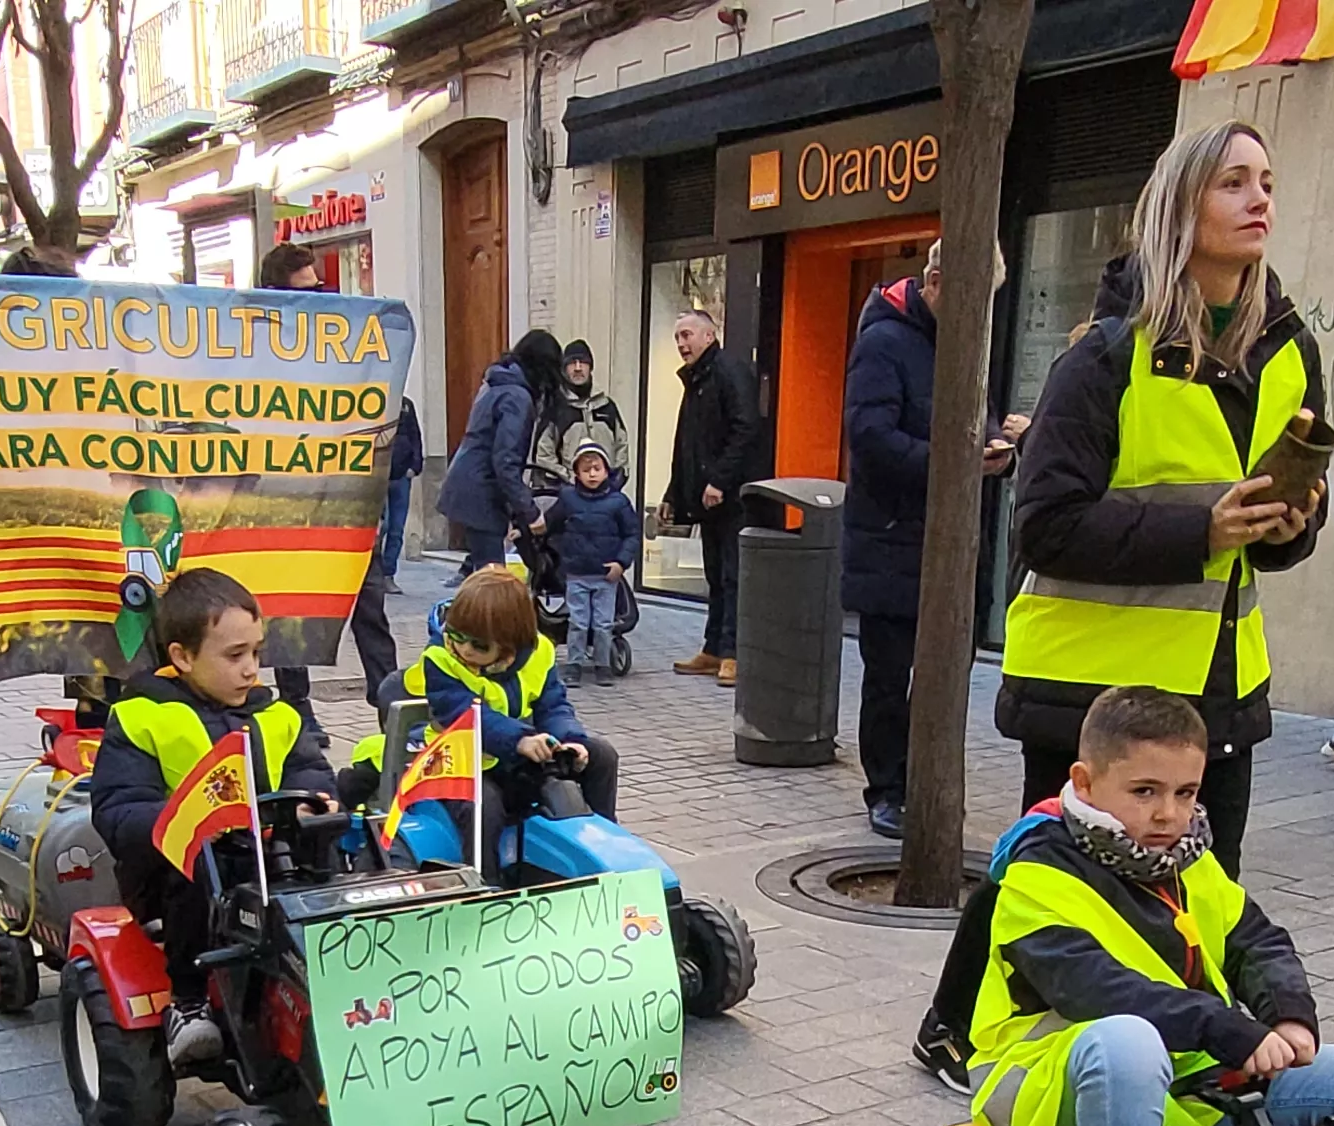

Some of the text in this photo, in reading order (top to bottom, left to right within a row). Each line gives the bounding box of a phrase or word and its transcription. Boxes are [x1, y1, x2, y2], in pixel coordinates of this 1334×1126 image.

[798, 134, 939, 202] Orange
[75, 369, 197, 419] FÁCIL
[205, 382, 387, 422] CUANDO
[81, 435, 177, 473] CON
[189, 437, 249, 473] UN
[263, 434, 374, 474] LÁPIZ
[344, 886, 403, 904] CASE
[318, 916, 402, 977] POR
[475, 896, 558, 954] POR
[387, 944, 634, 1026] POR TODOS
[339, 988, 681, 1100] APOYA AL CAMPO
